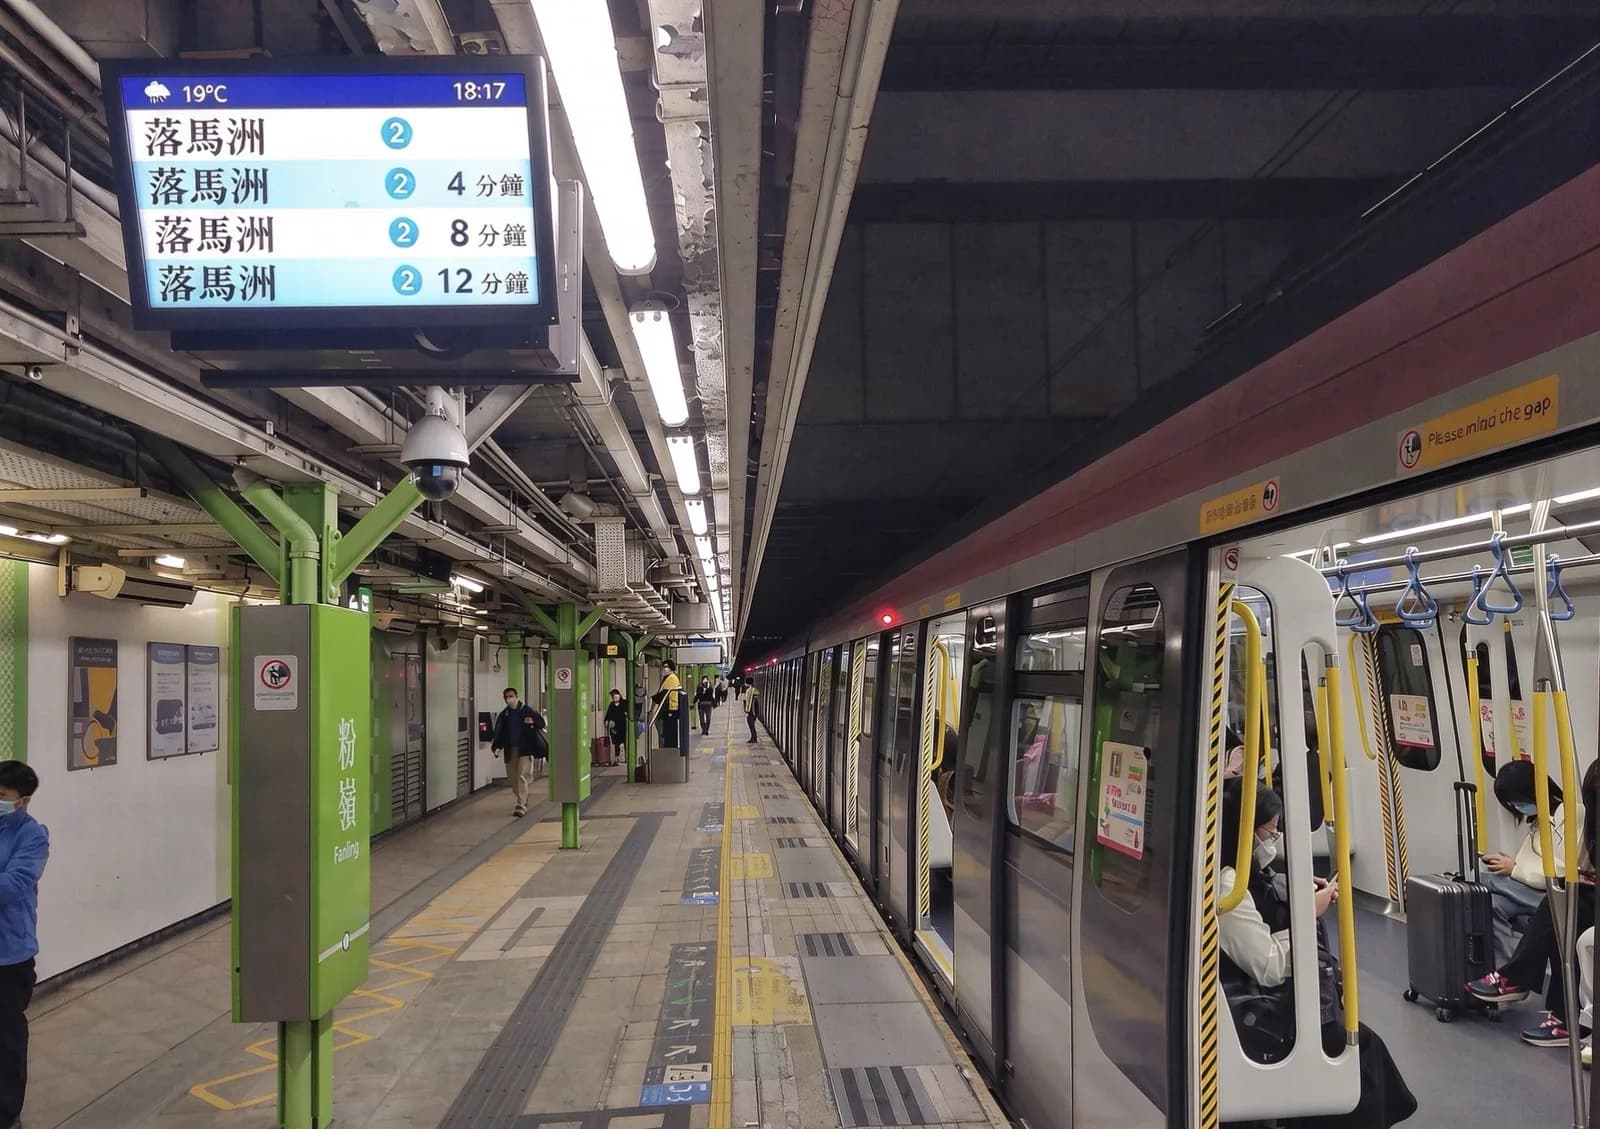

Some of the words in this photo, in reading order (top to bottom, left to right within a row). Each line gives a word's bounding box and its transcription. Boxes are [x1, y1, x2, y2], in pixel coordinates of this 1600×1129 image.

[453, 82, 505, 100] 18:17
[144, 117, 265, 157] 落馬洲
[149, 167, 269, 205] 落馬洲
[447, 171, 466, 195] 4
[476, 173, 524, 197] 分鐘
[155, 216, 273, 254] 落馬洲
[450, 220, 469, 247] 8
[478, 223, 527, 248] 分鐘
[158, 264, 276, 302] 落馬洲
[438, 268, 473, 294] 12
[480, 271, 529, 295] 分鐘
[1500, 406, 1521, 423] the
[1524, 397, 1551, 420] gap
[338, 717, 356, 831] 粉嶺
[334, 840, 359, 865] Fanling
